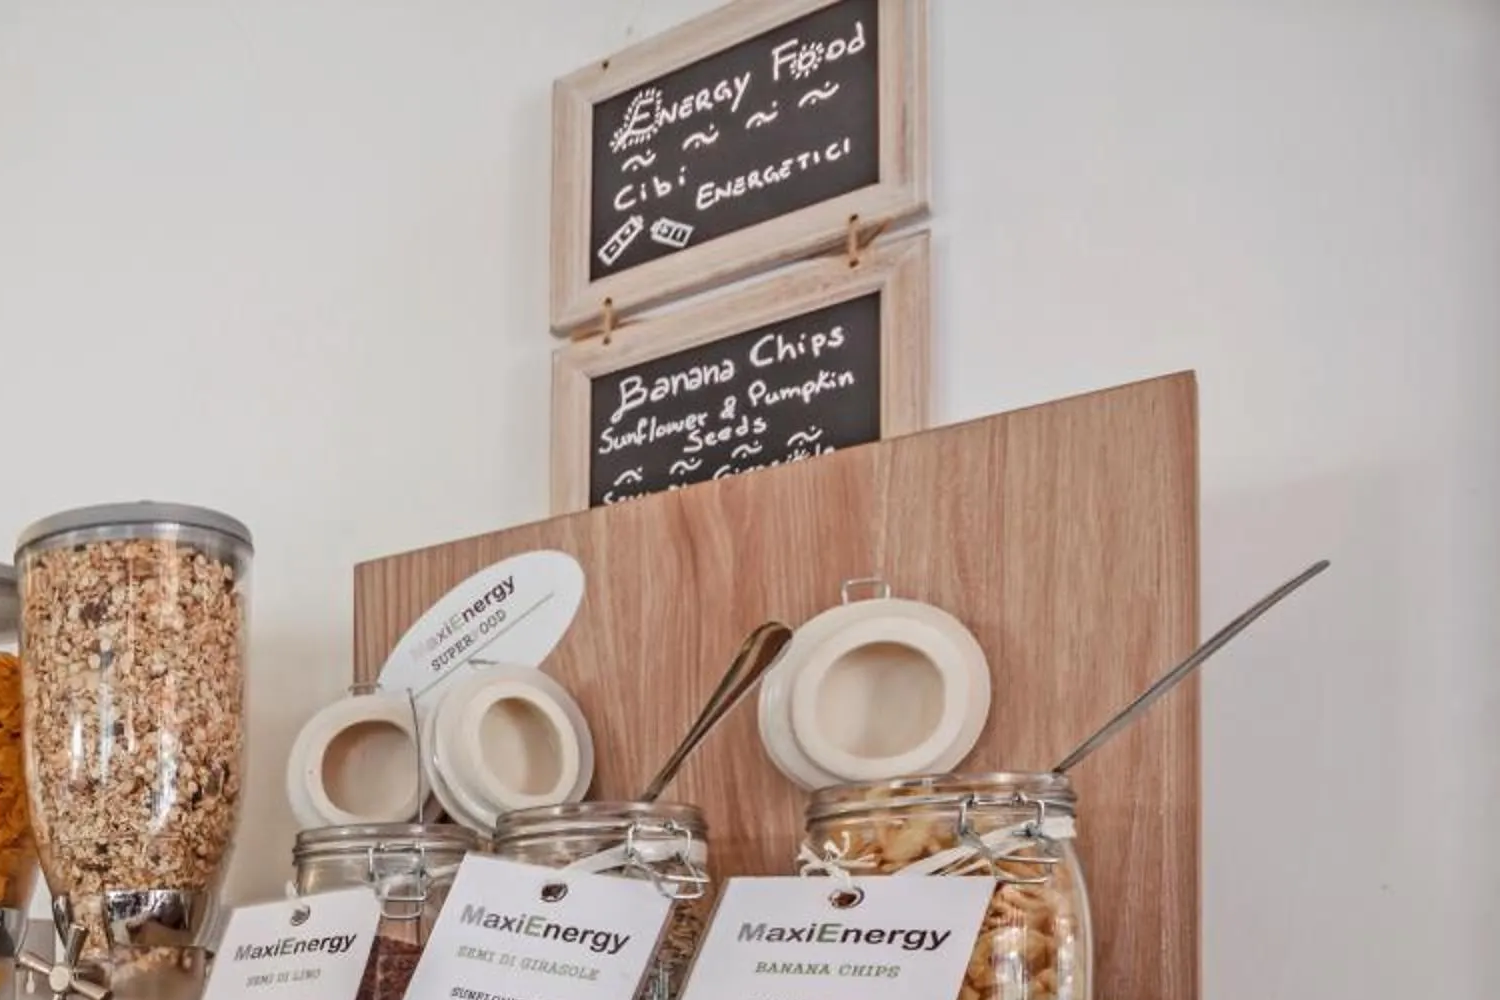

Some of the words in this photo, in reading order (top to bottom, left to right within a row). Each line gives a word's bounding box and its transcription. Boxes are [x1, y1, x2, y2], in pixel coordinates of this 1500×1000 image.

[771, 21, 866, 82] Food
[613, 164, 687, 212] Cibi
[696, 137, 851, 209] ENERGETICI
[611, 358, 735, 424] Banana
[748, 325, 846, 368] Chips
[599, 411, 707, 454] Sunflower
[747, 369, 855, 408] Pumpkin
[682, 417, 768, 454] Seeds
[234, 934, 357, 961] MaxiEnergy
[460, 903, 631, 955] MaxiEnergy
[737, 922, 952, 951] MaxiEnergy
[457, 945, 495, 965] SEMI
[499, 954, 516, 967] DI
[521, 957, 601, 981] GIRASOLE
[755, 961, 830, 976] BANANA
[838, 964, 901, 978] CHIPS
